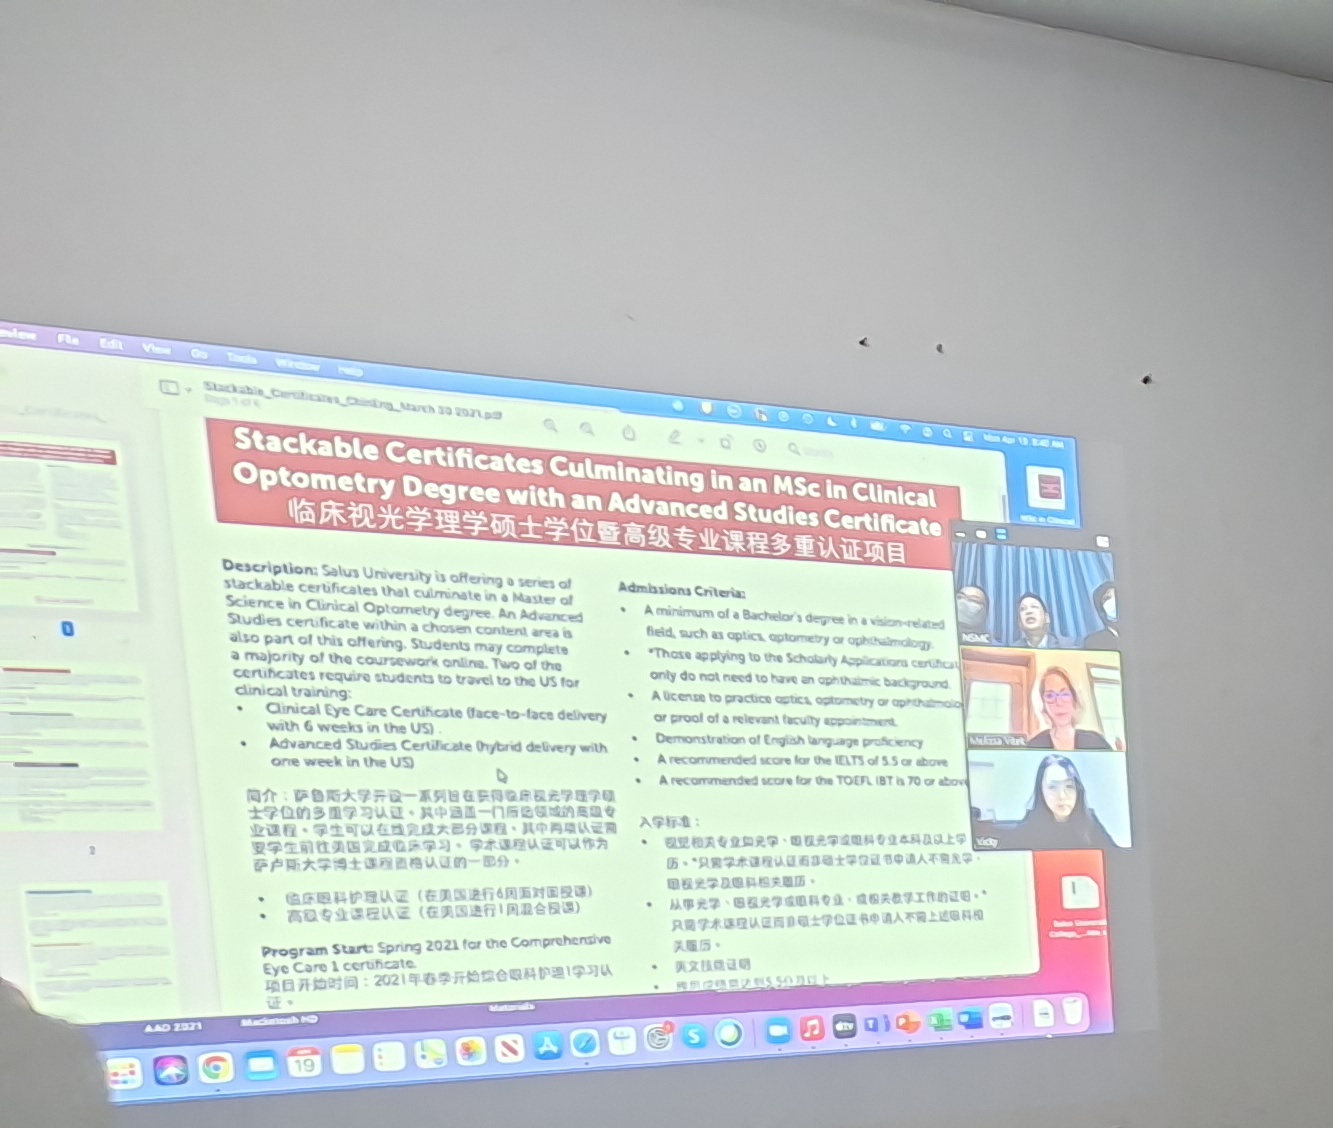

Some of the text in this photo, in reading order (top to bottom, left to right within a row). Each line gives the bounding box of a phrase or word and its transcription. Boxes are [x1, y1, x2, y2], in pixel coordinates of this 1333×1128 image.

[142, 343, 172, 355] View
[234, 427, 937, 508] Stackable Certificates Culminating in an MSc in Clinical
[233, 461, 942, 537] Optometry Degree with an Advanced Studies Certificate
[288, 496, 907, 564] 临床视光学理学硕士学位暨高级专业课程多重认证项目
[222, 558, 572, 590] Description: Salus University is offering series of
[224, 578, 574, 606] stackable certificates that culminate in Master of
[225, 594, 285, 610] Science
[288, 597, 302, 610] in
[305, 598, 359, 613] Clinical
[362, 601, 440, 620] Optometry
[498, 607, 517, 620] An
[520, 609, 583, 623] Advanced
[227, 612, 560, 639] Studies certificate within chosen content area
[229, 630, 260, 644] also
[263, 634, 295, 647] part
[297, 633, 313, 646] of
[316, 634, 343, 647] this
[410, 637, 471, 652] Students
[474, 642, 503, 656] may
[506, 643, 569, 657] complete
[244, 649, 305, 666] majority
[309, 651, 325, 664] of
[328, 652, 353, 666] the
[356, 655, 439, 667] coursework
[491, 657, 520, 671] Two
[523, 659, 537, 671] of
[540, 660, 562, 672] the
[232, 667, 536, 688] certificates require students travel the
[234, 684, 352, 702] clinical training:
[265, 702, 321, 716] Clinical
[324, 703, 351, 719] Eye
[354, 704, 387, 718] Care
[390, 705, 463, 719] Certificate
[557, 709, 607, 724] delivery
[266, 720, 300, 732] with
[316, 721, 363, 734] weeks
[384, 722, 407, 735] the
[269, 737, 342, 751] Advanced
[345, 738, 397, 752] Studies
[400, 739, 472, 752] Certificate
[526, 741, 577, 756] delivery
[579, 742, 608, 753] with
[270, 757, 300, 767] one
[303, 755, 343, 767] week
[363, 756, 387, 768] the
[261, 934, 611, 960] Program Start: Spring 2021 the Comprehensive
[262, 962, 289, 978] Eye
[292, 962, 327, 974] Care
[294, 1058, 315, 1072] 19
